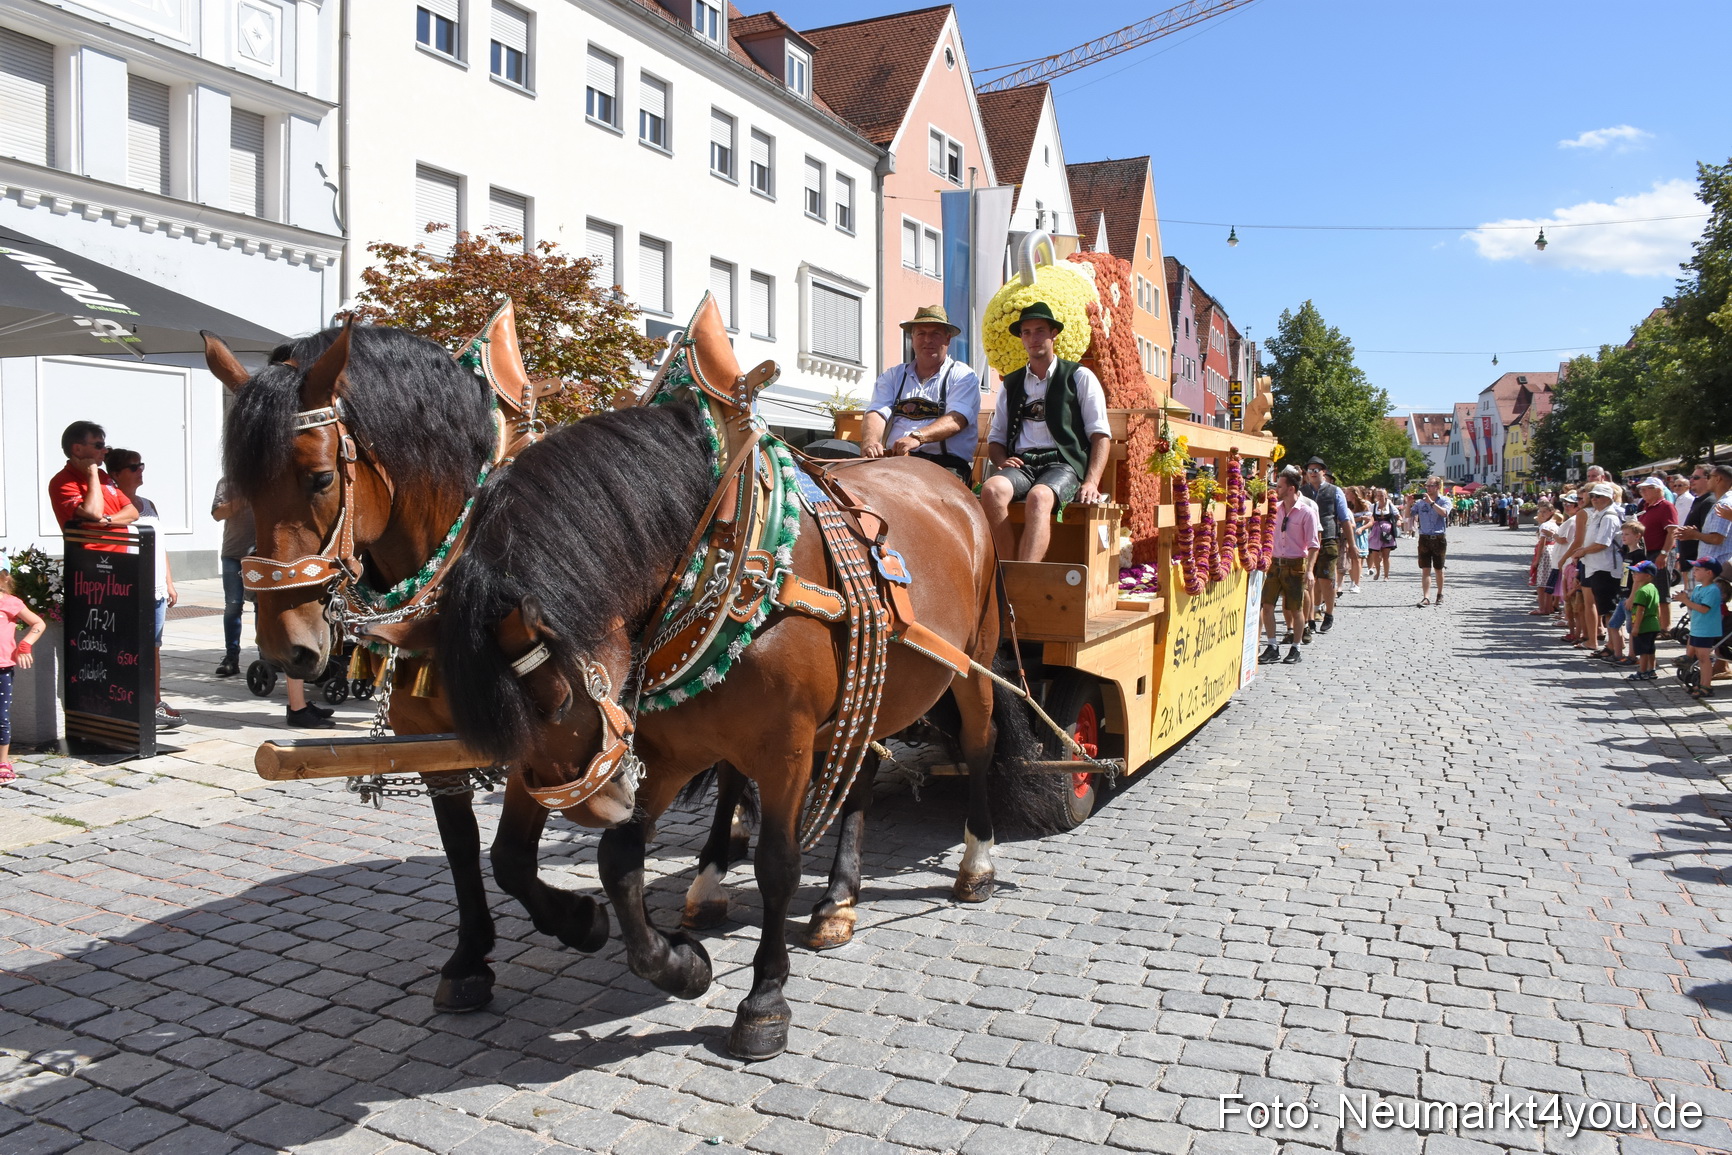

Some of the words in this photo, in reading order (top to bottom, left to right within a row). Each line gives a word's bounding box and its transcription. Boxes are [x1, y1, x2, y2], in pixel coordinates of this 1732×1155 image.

[1230, 382, 1242, 431] HOTE
[74, 571, 106, 605] Happy
[107, 574, 133, 596] Hour
[85, 608, 115, 632] 17-21
[78, 630, 108, 653] Cocktails
[1193, 615, 1217, 669] Pius
